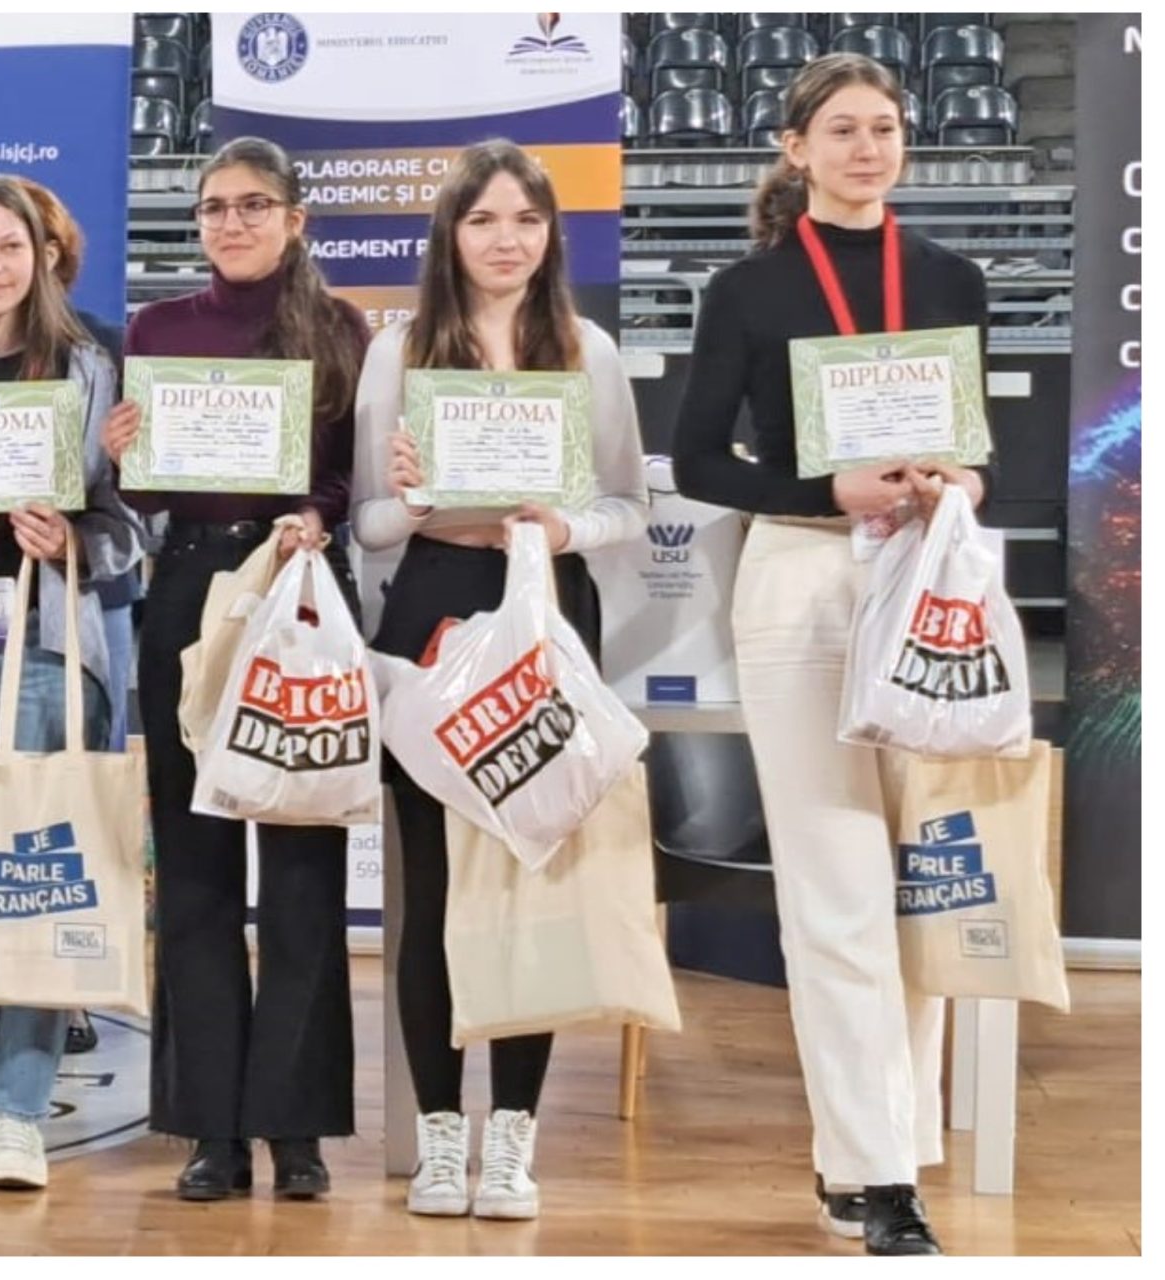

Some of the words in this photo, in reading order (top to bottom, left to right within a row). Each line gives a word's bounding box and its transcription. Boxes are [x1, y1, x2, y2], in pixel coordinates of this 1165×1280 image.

[293, 158, 423, 179] OLABORARE
[308, 239, 413, 259] AGEMENT
[830, 362, 944, 389] DIPLOMA
[160, 388, 275, 409] DIPLOMA
[441, 401, 556, 423] DIPLOMA
[28, 829, 52, 854] JE
[924, 820, 952, 845] JE
[0, 859, 66, 883] PARLE
